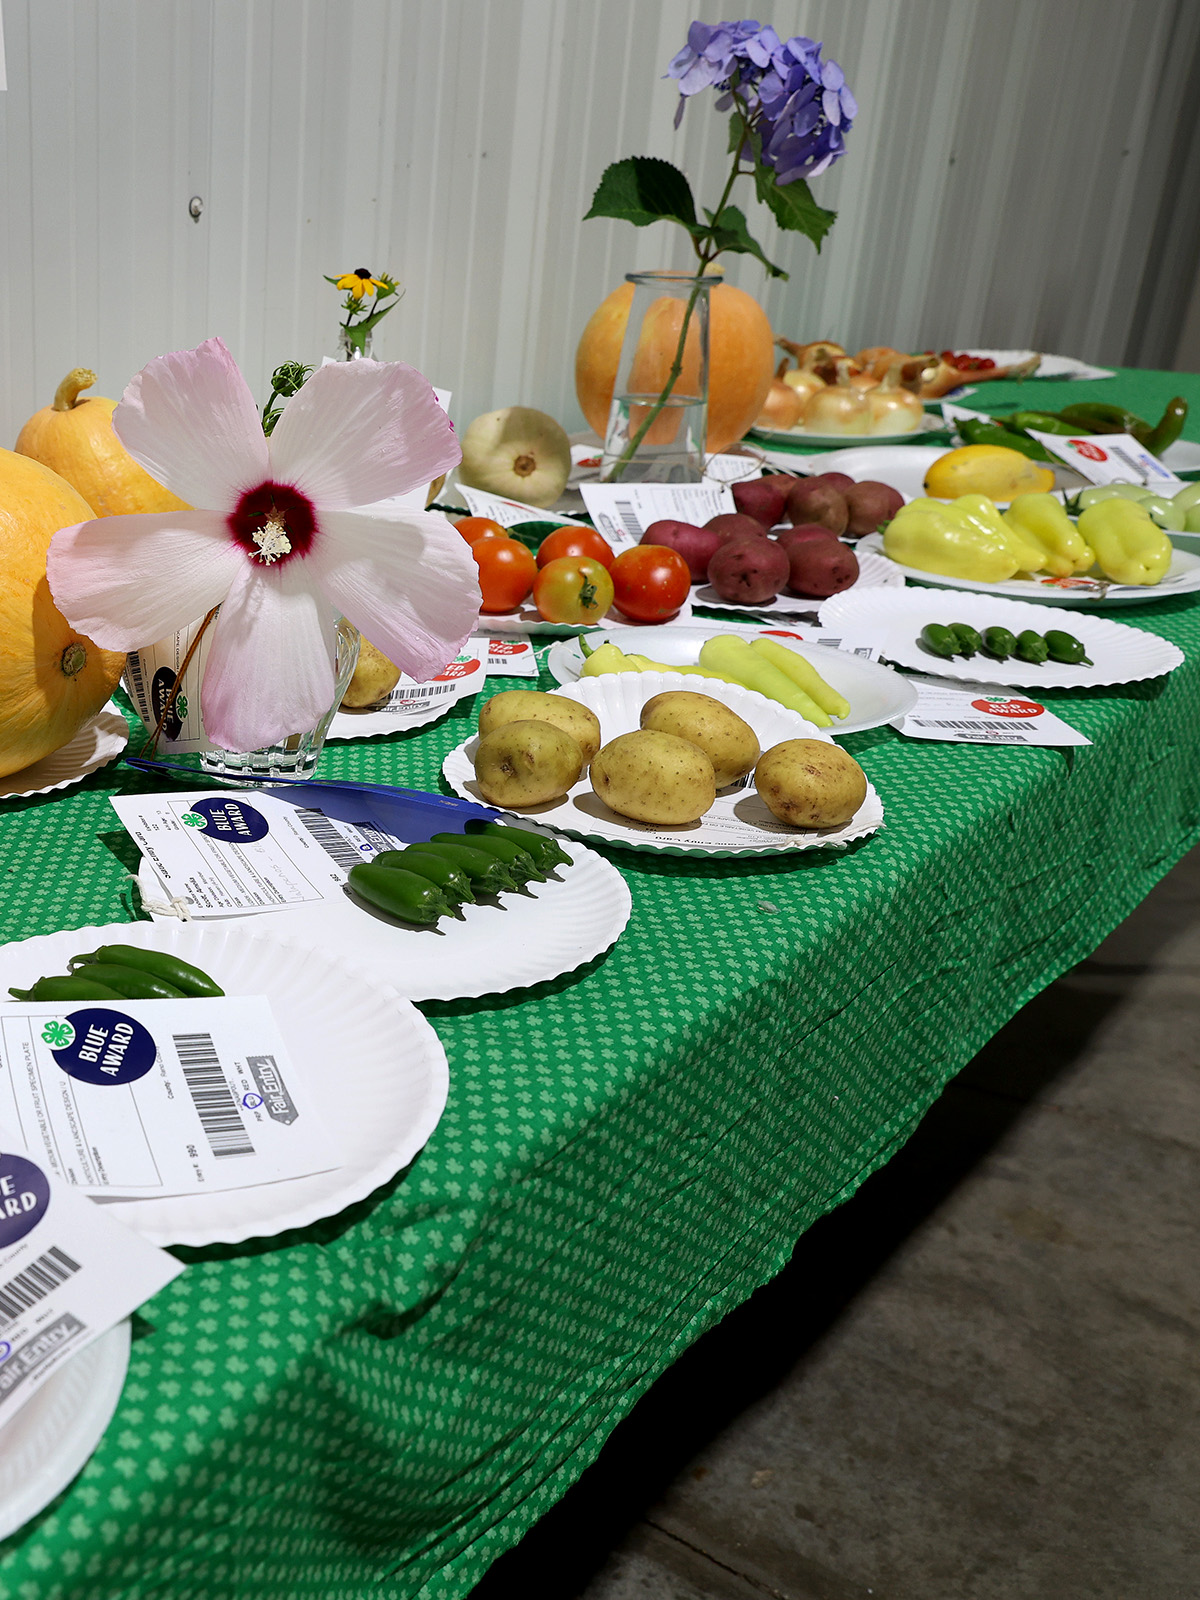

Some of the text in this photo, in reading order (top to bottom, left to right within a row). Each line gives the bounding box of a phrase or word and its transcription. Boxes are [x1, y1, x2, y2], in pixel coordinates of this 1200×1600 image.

[209, 809, 232, 830] BLUE
[225, 803, 252, 836] AWARD
[22, 1042, 31, 1061] PLATE
[78, 1024, 109, 1062] BLUE
[100, 1023, 133, 1076] AWARD
[27, 1062, 38, 1091] SPECIMEN
[234, 1062, 243, 1074] WHT
[164, 1081, 174, 1099] County:
[241, 1080, 249, 1091] RED
[62, 1090, 72, 1110] DESIGN
